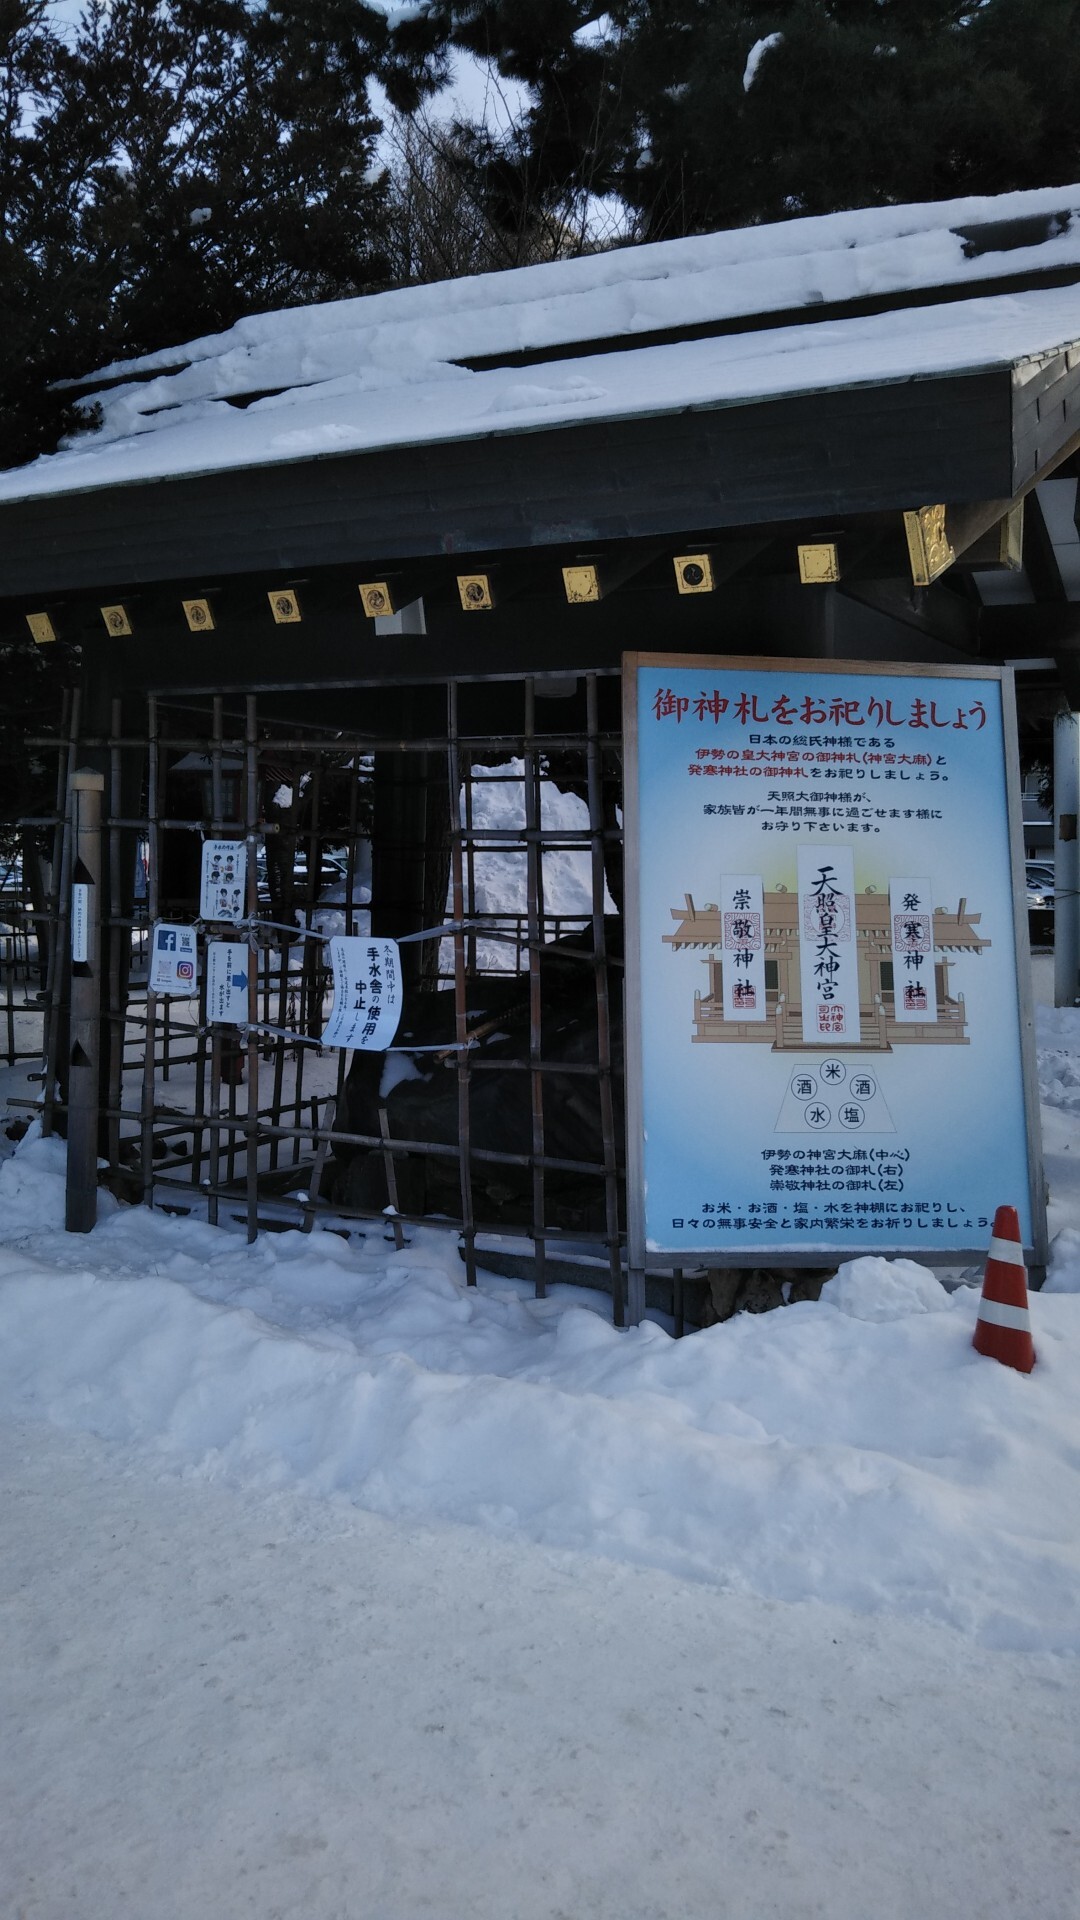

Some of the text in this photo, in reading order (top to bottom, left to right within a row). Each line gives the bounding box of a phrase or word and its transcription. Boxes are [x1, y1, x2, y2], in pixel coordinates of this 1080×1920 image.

[651, 687, 987, 731] 御神札をお祀りしましょう
[749, 734, 896, 749] 日本の総氏神様である
[687, 763, 949, 781] 発寒神社の御神札をお祀りしましょう。
[767, 790, 872, 803] 天照大御神様が、
[703, 803, 943, 820] 家族皆が一年間無事に過ごせます様に
[761, 820, 881, 833] お守り下さいます。
[809, 865, 844, 1001] 天照皇大神宮
[901, 892, 926, 1001] 発寒神社
[383, 944, 396, 1005] 冬期間中は
[361, 947, 383, 1045] 手水舎の使用を
[346, 979, 367, 1043] 中止します
[825, 1064, 841, 1080] 米
[796, 1079, 813, 1095] 酒
[855, 1080, 871, 1096] 酒
[810, 1109, 826, 1123] 水
[844, 1108, 860, 1124] 塩
